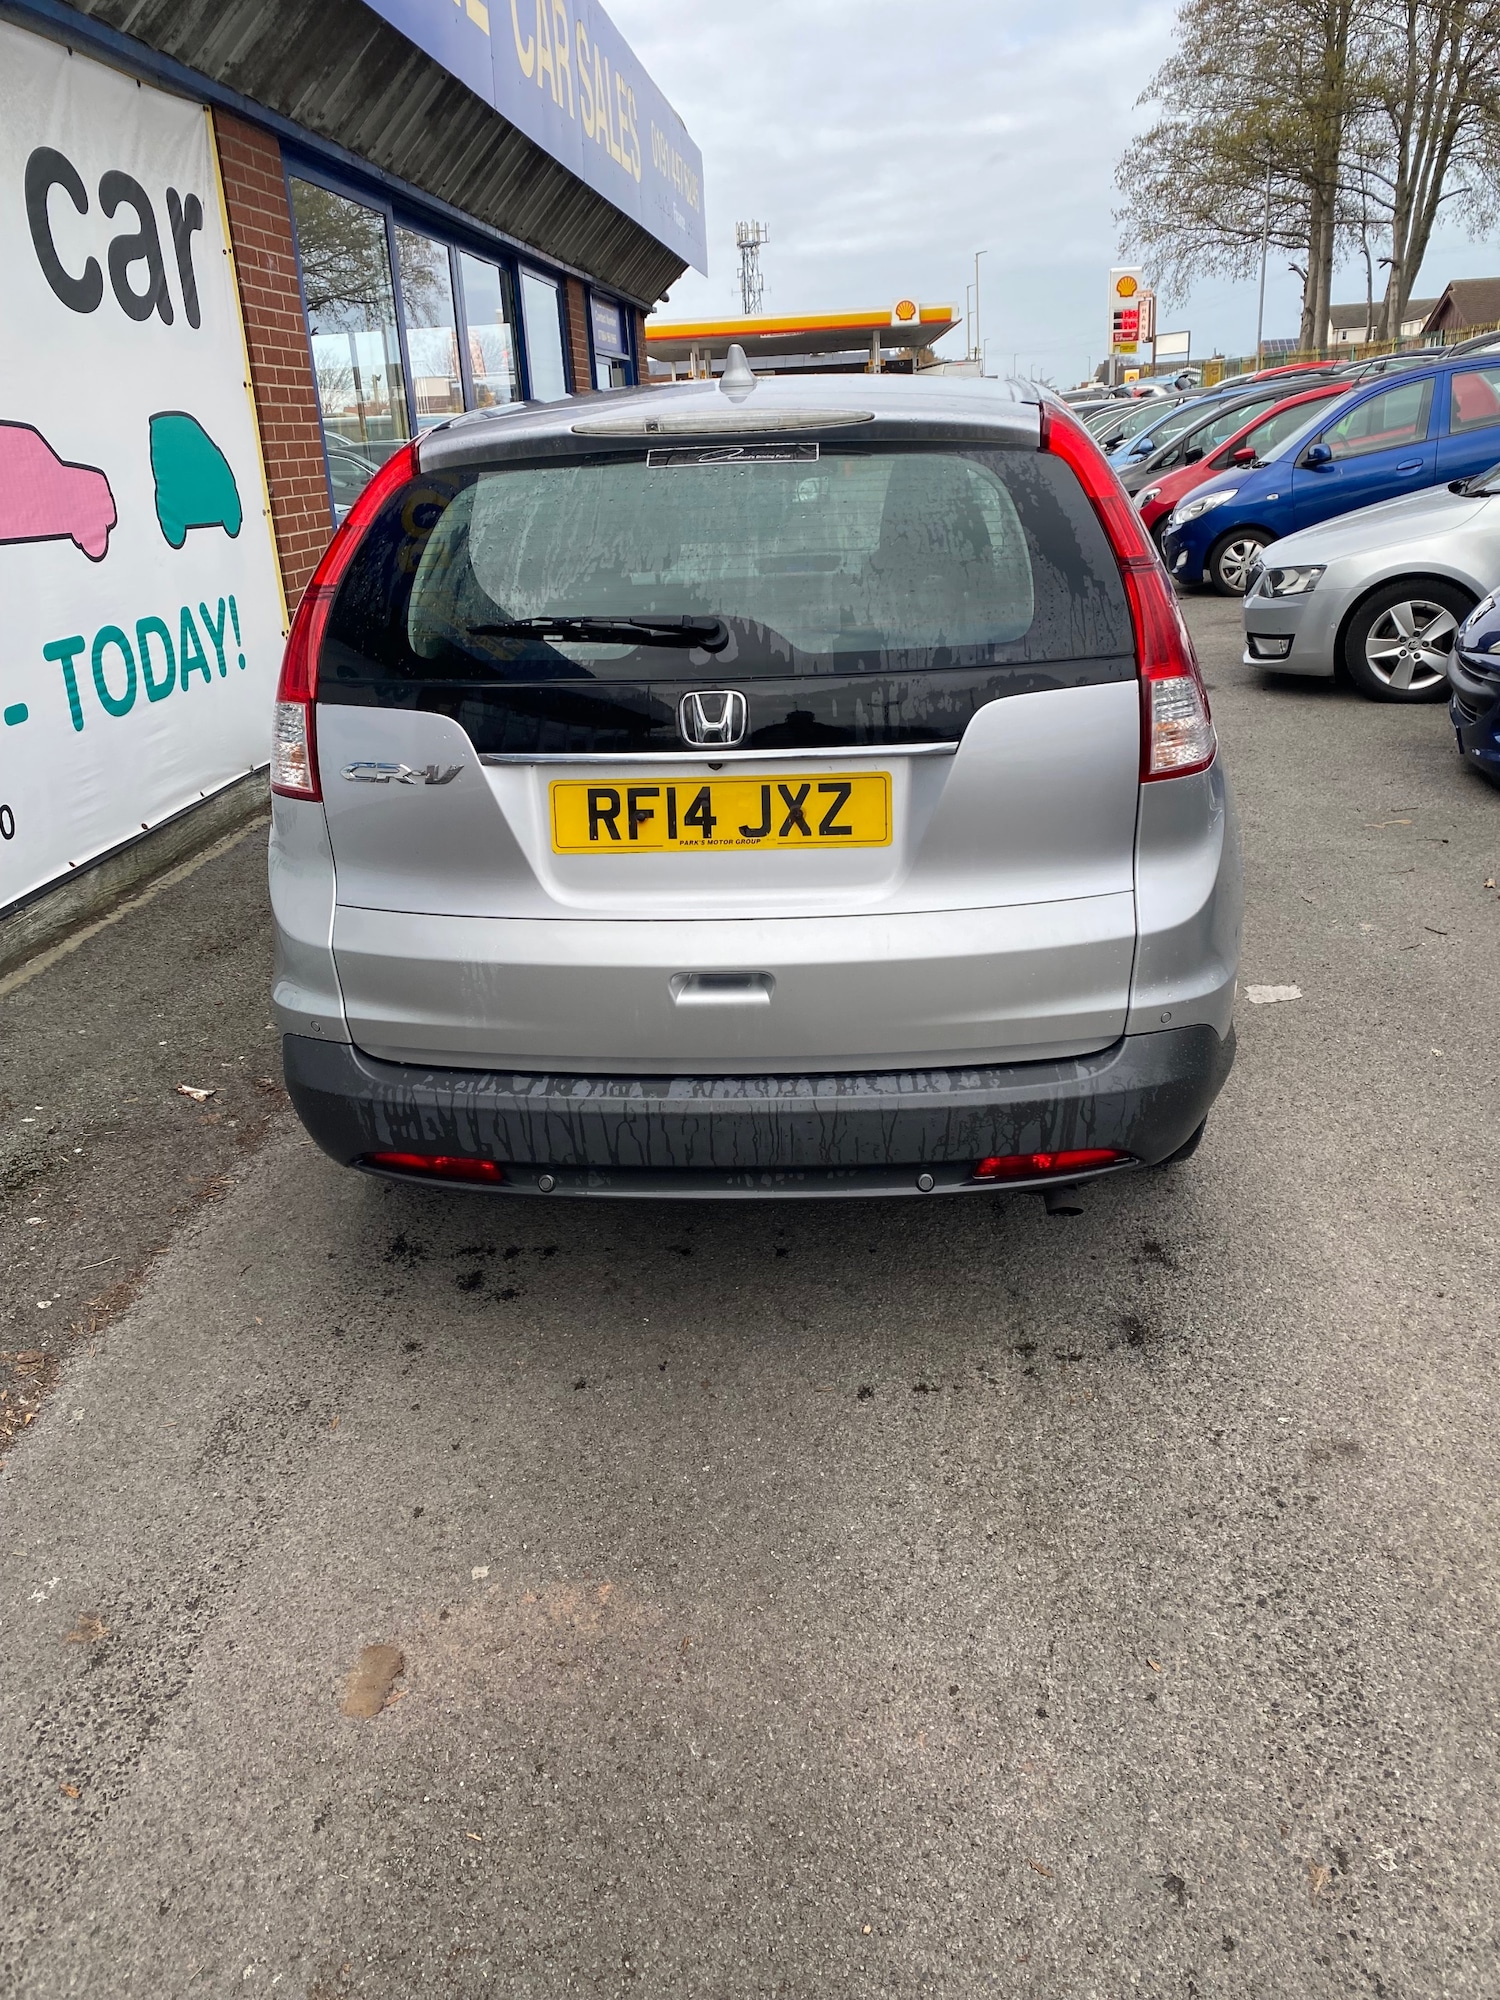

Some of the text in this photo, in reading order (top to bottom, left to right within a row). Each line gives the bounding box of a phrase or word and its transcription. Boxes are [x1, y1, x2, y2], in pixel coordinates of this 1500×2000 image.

[511, 0, 642, 184] CAR SALES
[25, 146, 203, 329] car
[43, 594, 248, 732] TODAY!
[340, 761, 465, 785] CR-V
[587, 782, 853, 841] RF14 JXZ
